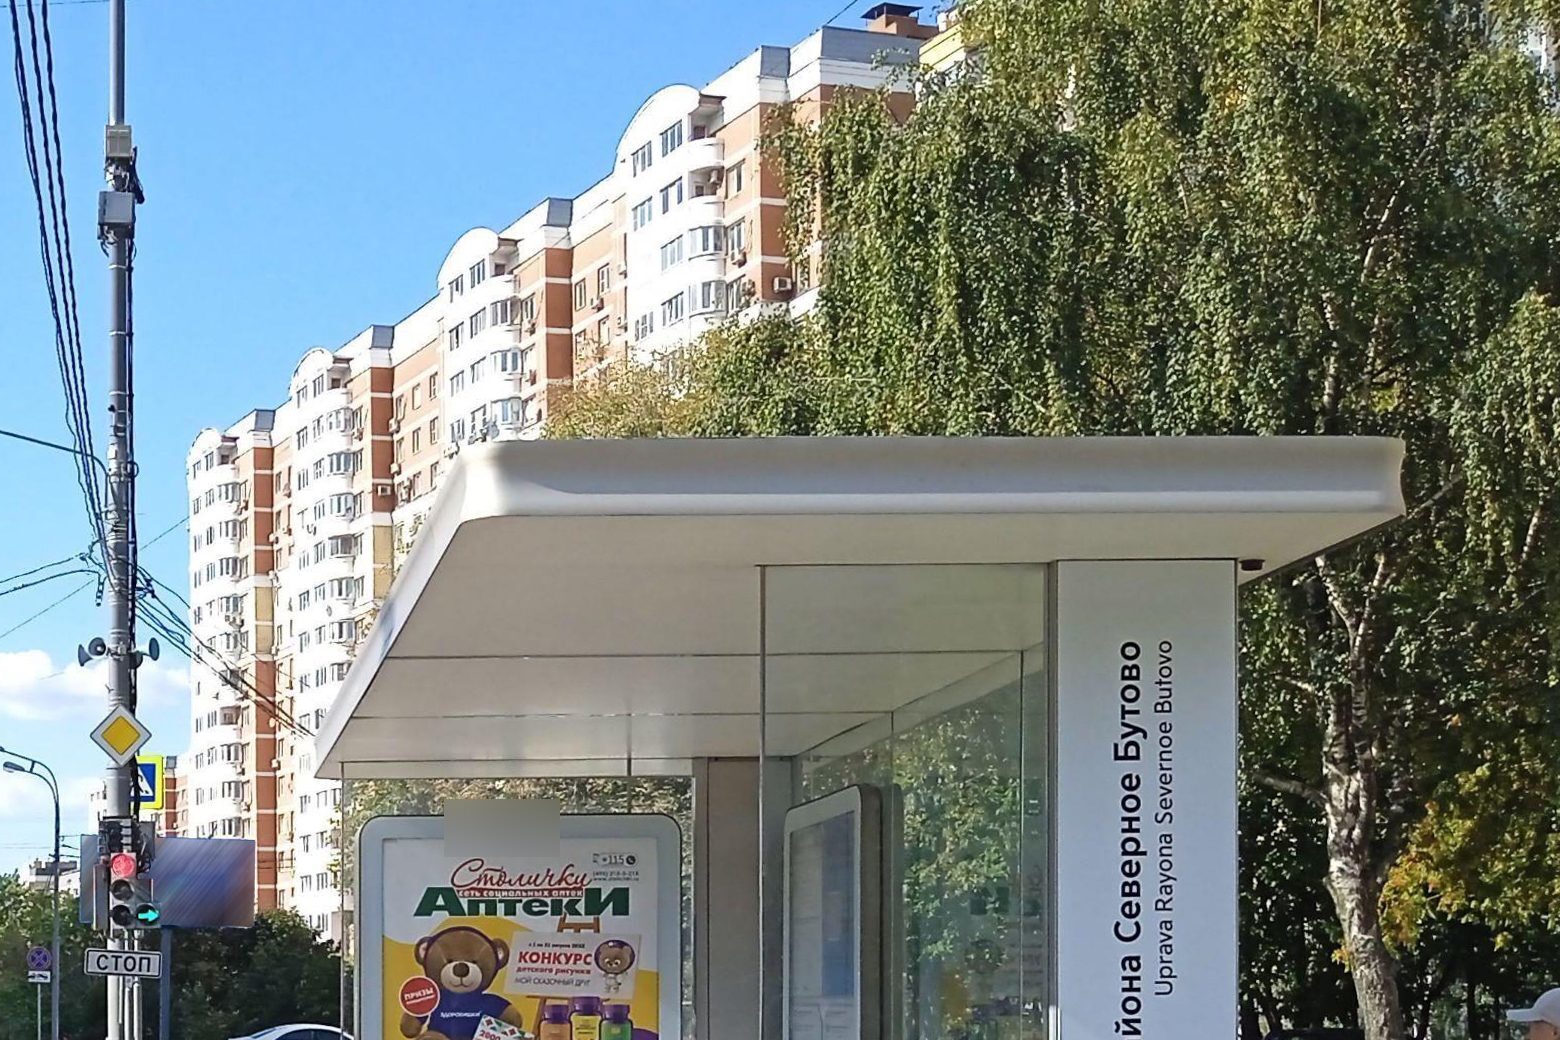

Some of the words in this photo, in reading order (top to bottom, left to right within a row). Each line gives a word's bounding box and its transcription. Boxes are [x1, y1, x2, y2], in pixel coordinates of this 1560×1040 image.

[1113, 641, 1148, 762] Бутово
[1155, 640, 1173, 714] Butovo
[1155, 721, 1173, 825] Severnoe
[451, 857, 591, 889] Столички
[458, 889, 481, 897] сеть
[483, 890, 550, 899] социальных
[552, 889, 584, 897] аптек
[1113, 772, 1148, 943] Северное
[1155, 833, 1178, 912] Rayona
[96, 954, 151, 973] СТОП
[516, 966, 554, 974] детского
[519, 951, 593, 966] КОНКУРС
[1155, 919, 1178, 996] Uprava
